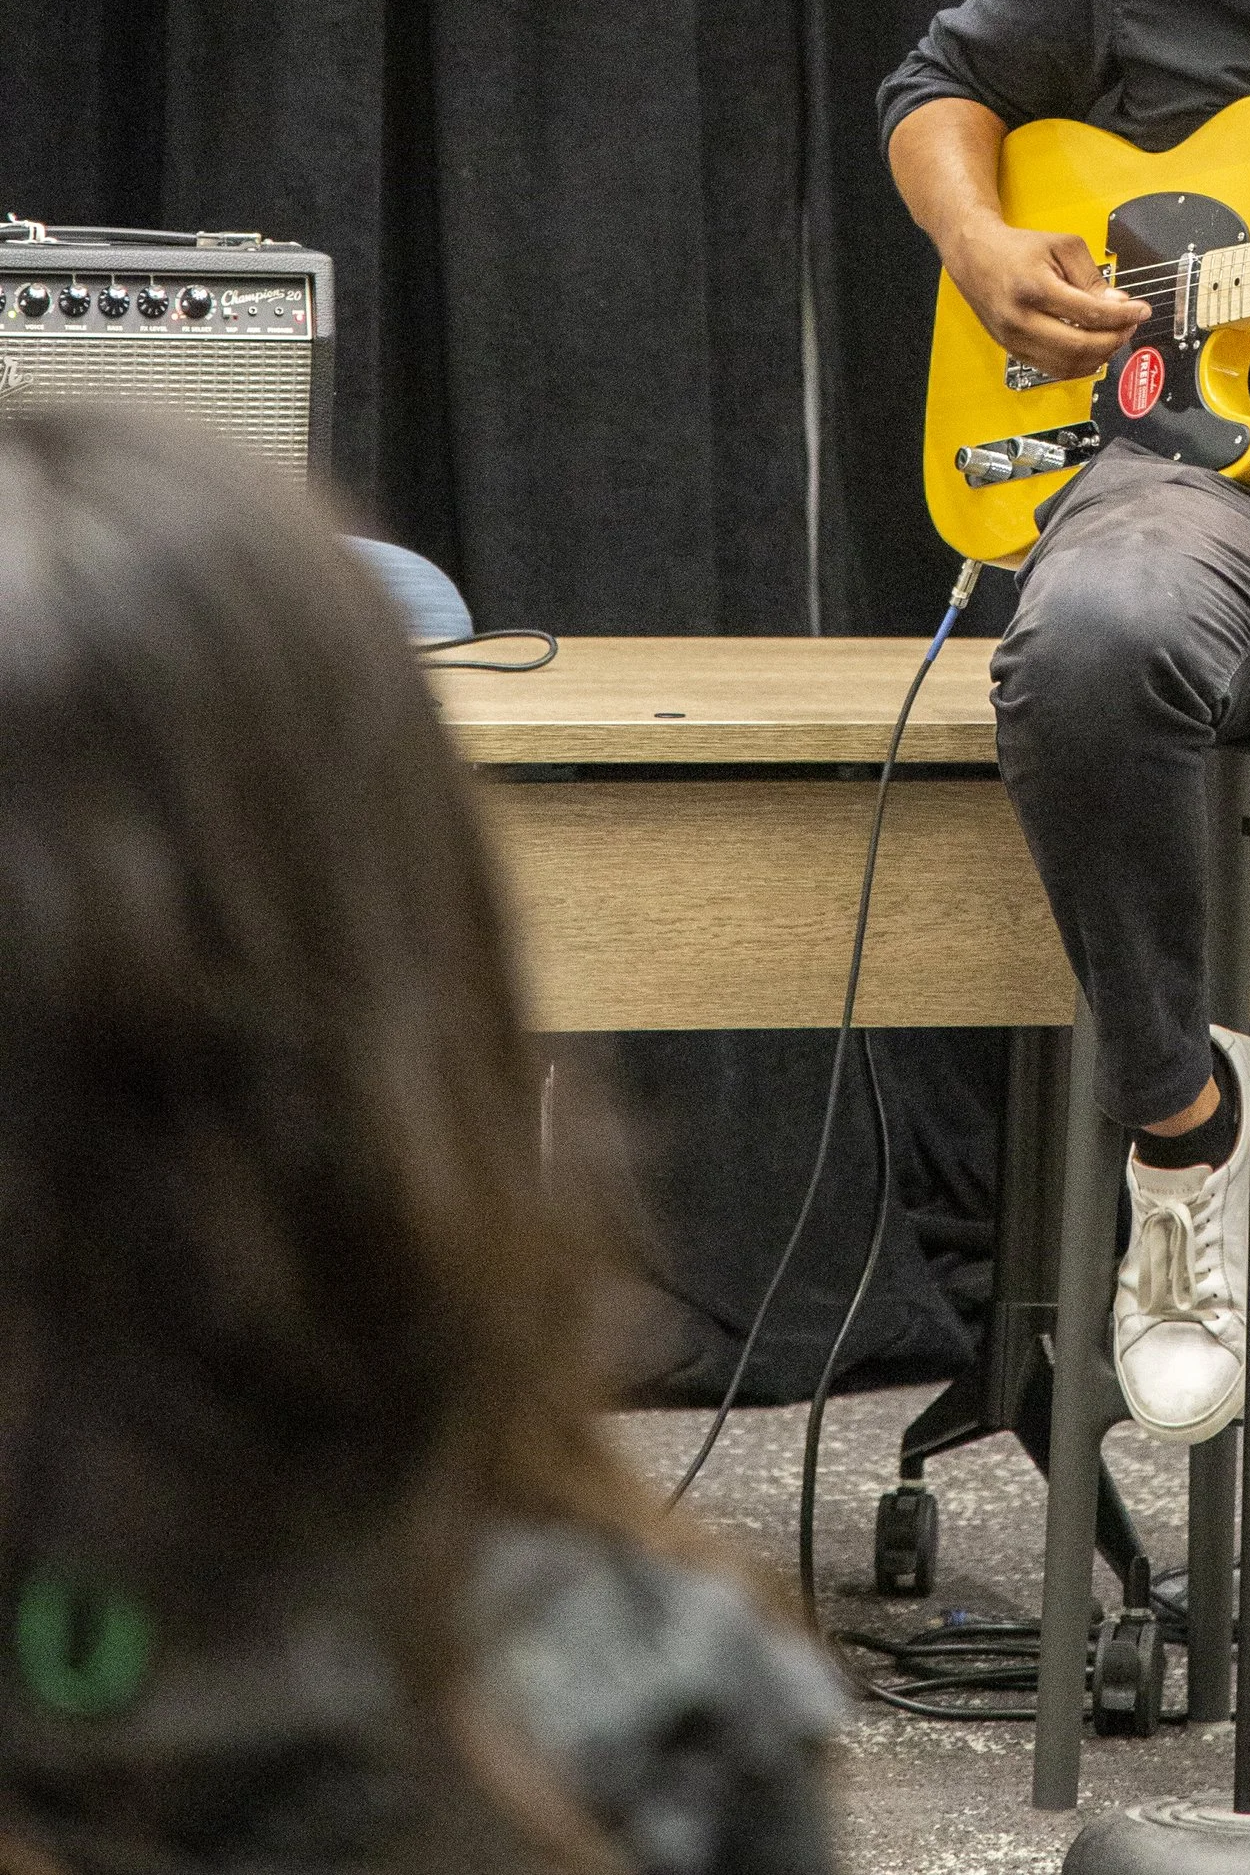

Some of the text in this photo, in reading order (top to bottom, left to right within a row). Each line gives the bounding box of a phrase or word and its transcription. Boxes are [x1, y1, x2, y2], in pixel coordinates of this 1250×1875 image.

[221, 288, 302, 306] Champion 20
[1139, 353, 1150, 386] FREE
